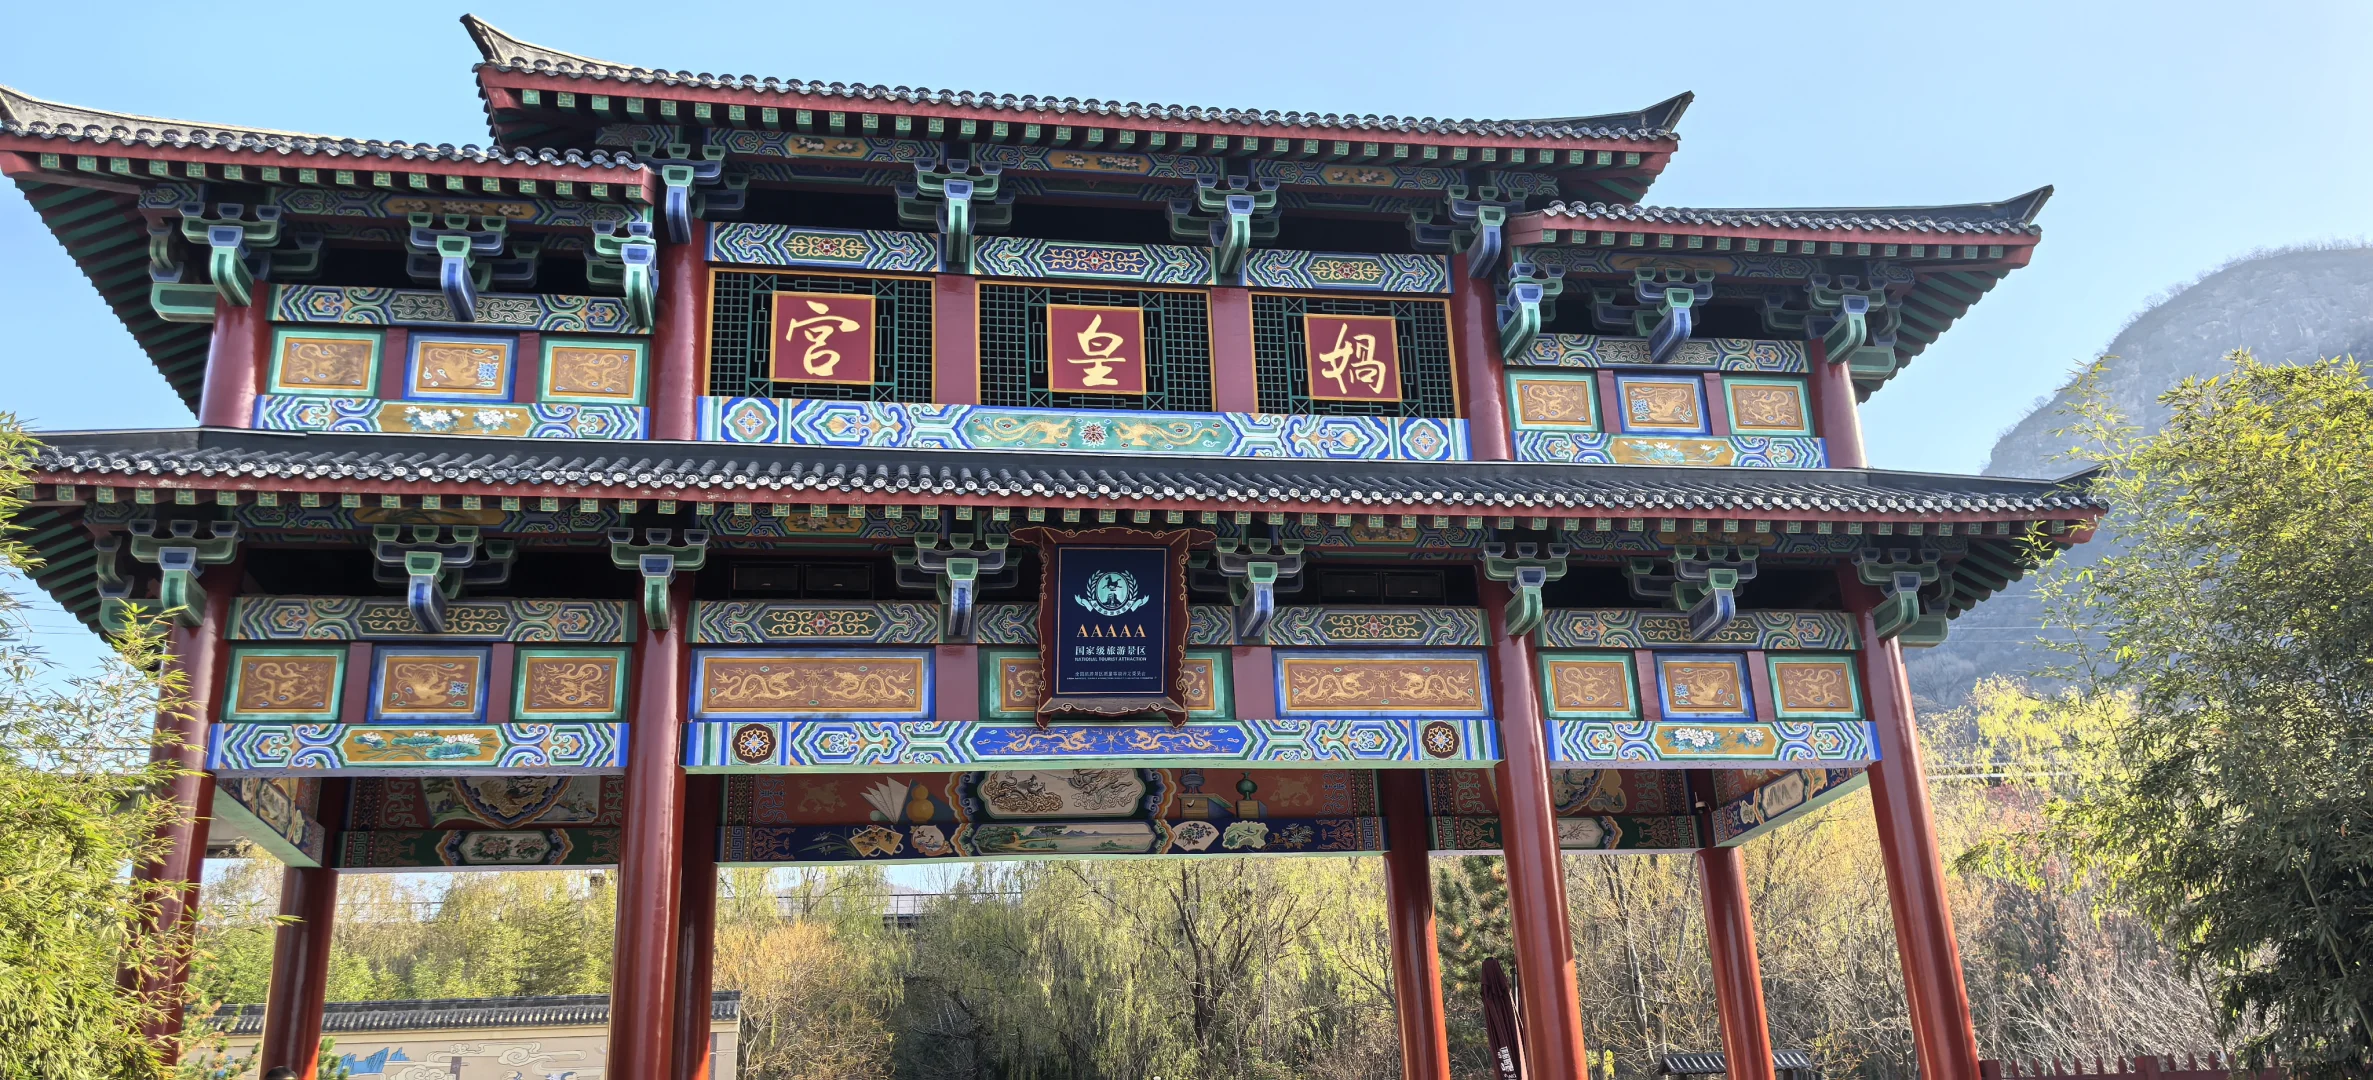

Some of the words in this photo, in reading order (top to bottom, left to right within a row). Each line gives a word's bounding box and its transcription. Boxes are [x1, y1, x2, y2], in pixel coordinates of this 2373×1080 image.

[1066, 313, 1127, 387] 皇
[1076, 623, 1147, 638] AAAAA
[1075, 645, 1147, 656] 国家级旅游景区
